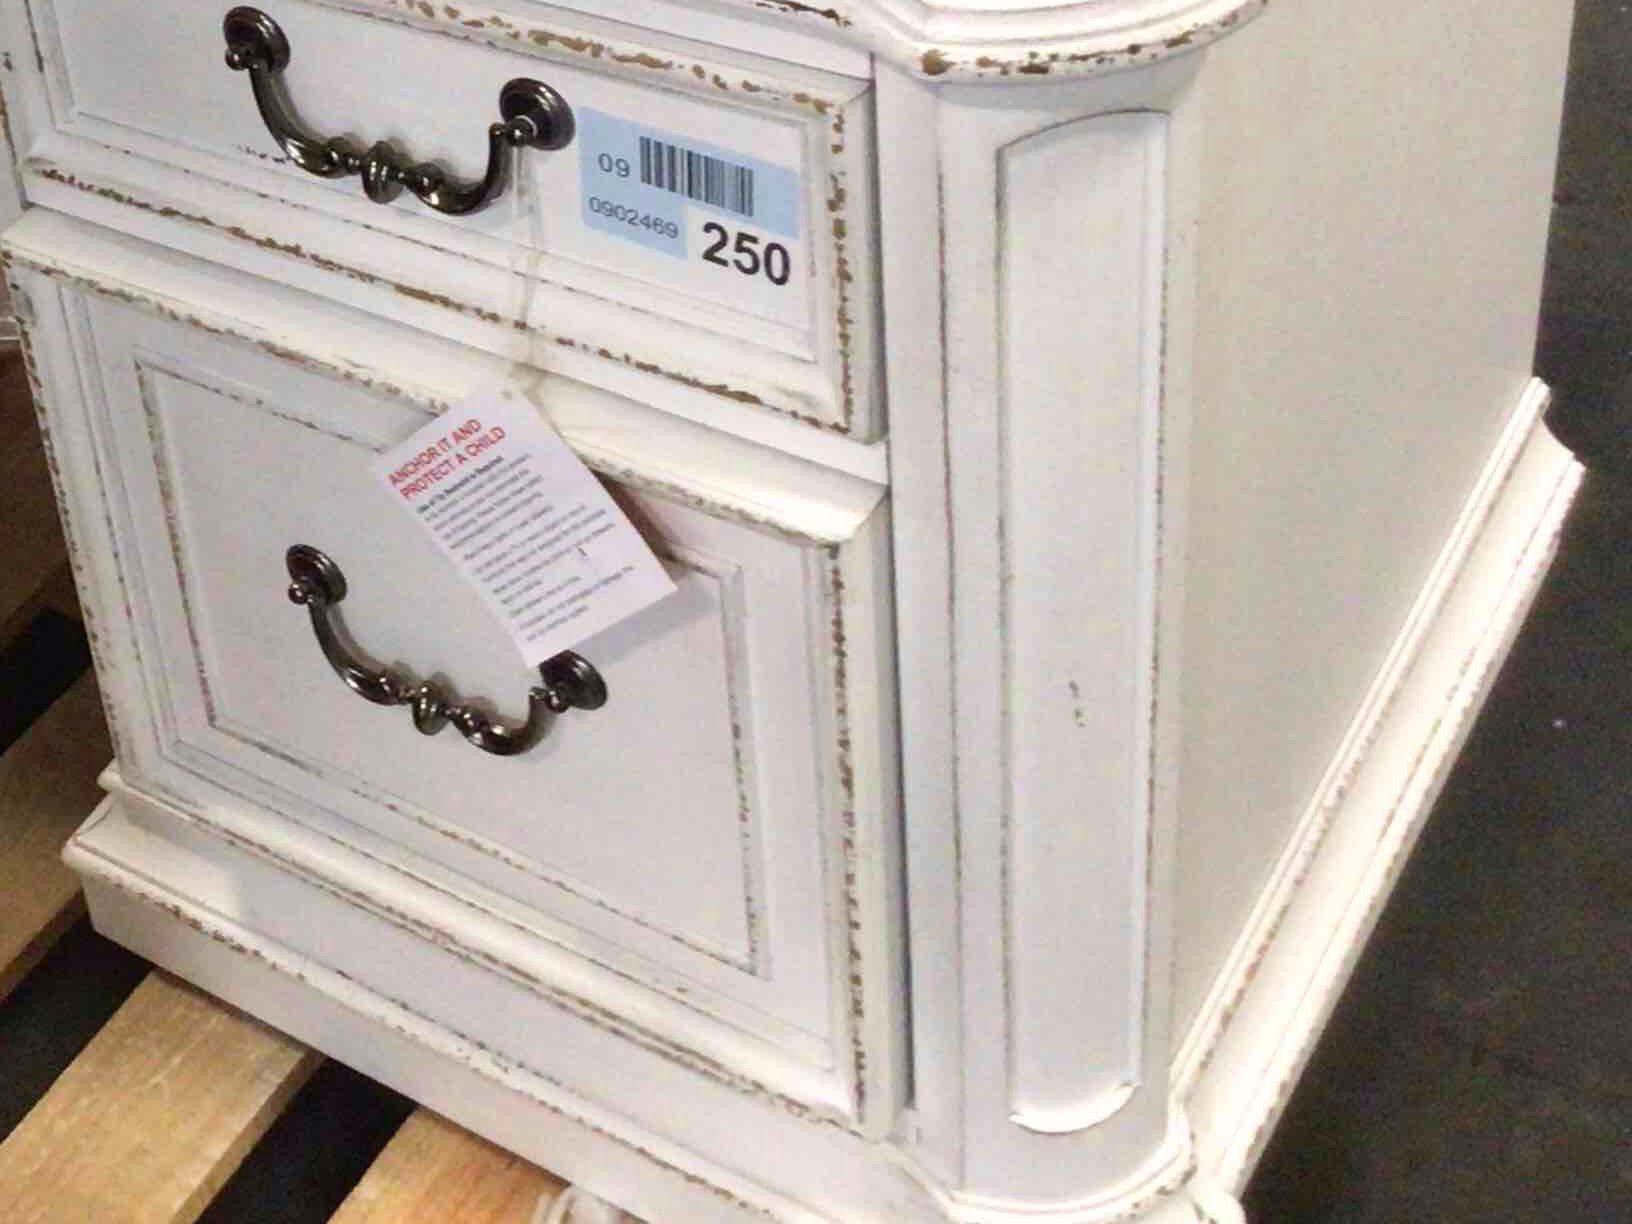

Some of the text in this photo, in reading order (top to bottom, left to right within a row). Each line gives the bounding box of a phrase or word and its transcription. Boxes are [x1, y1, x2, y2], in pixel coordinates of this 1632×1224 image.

[598, 153, 630, 178] 09
[589, 197, 679, 239] 0902469
[702, 222, 790, 286] 250
[389, 419, 481, 485] ANCHOR IT AND
[400, 426, 505, 498] PROTECT A CHILD
